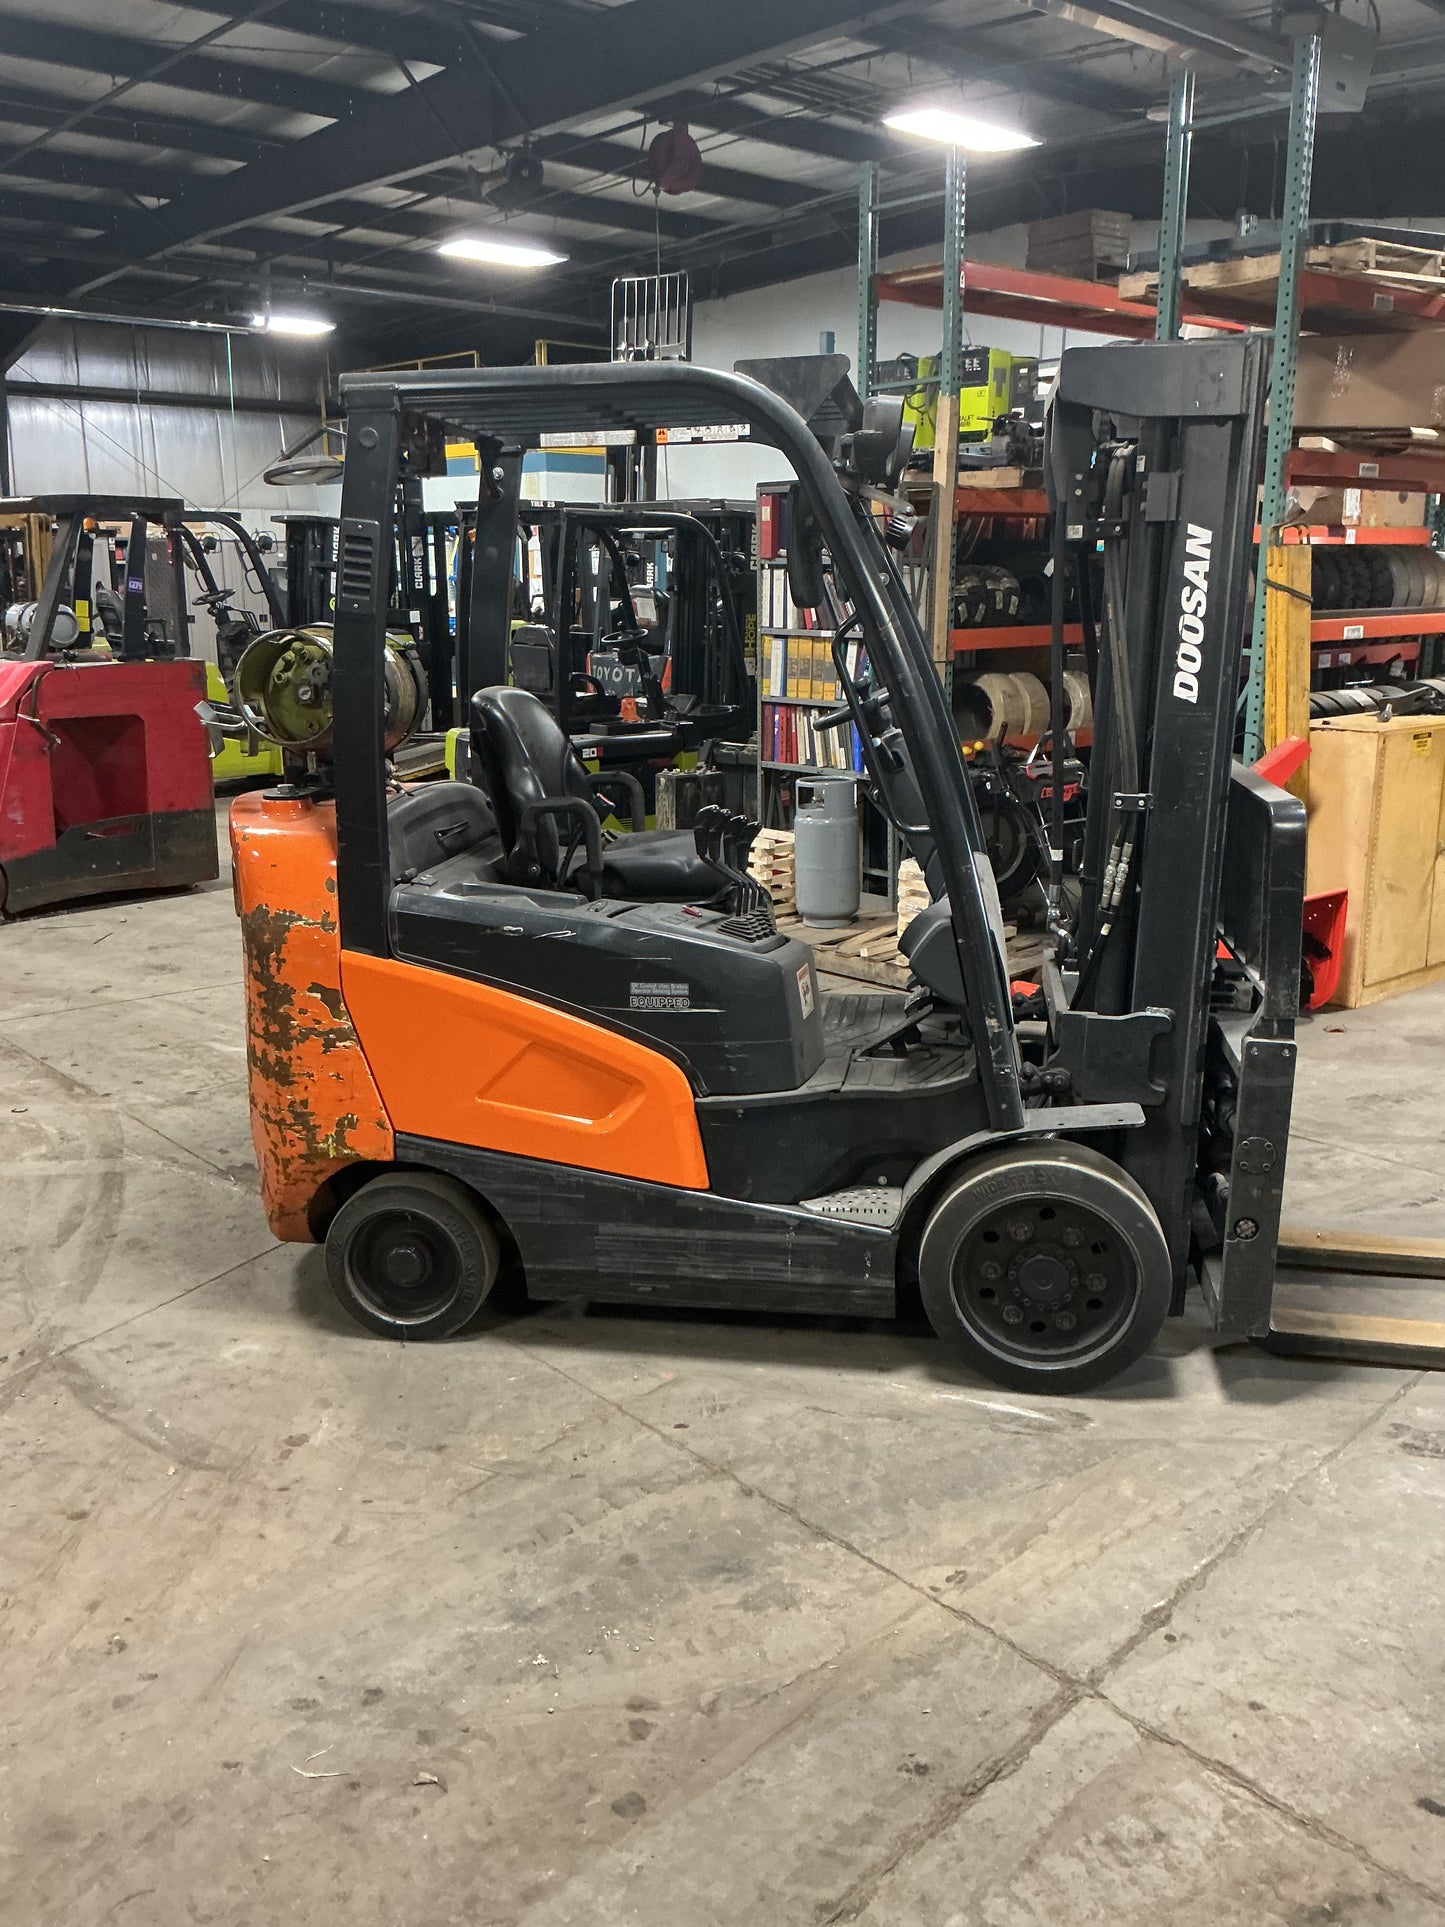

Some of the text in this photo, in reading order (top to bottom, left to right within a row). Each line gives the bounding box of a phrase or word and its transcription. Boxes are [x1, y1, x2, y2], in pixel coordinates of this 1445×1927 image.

[413, 557, 424, 589] CLARK
[1173, 523, 1213, 704] DOOSAN
[630, 996, 690, 1008] EQUIPPED
